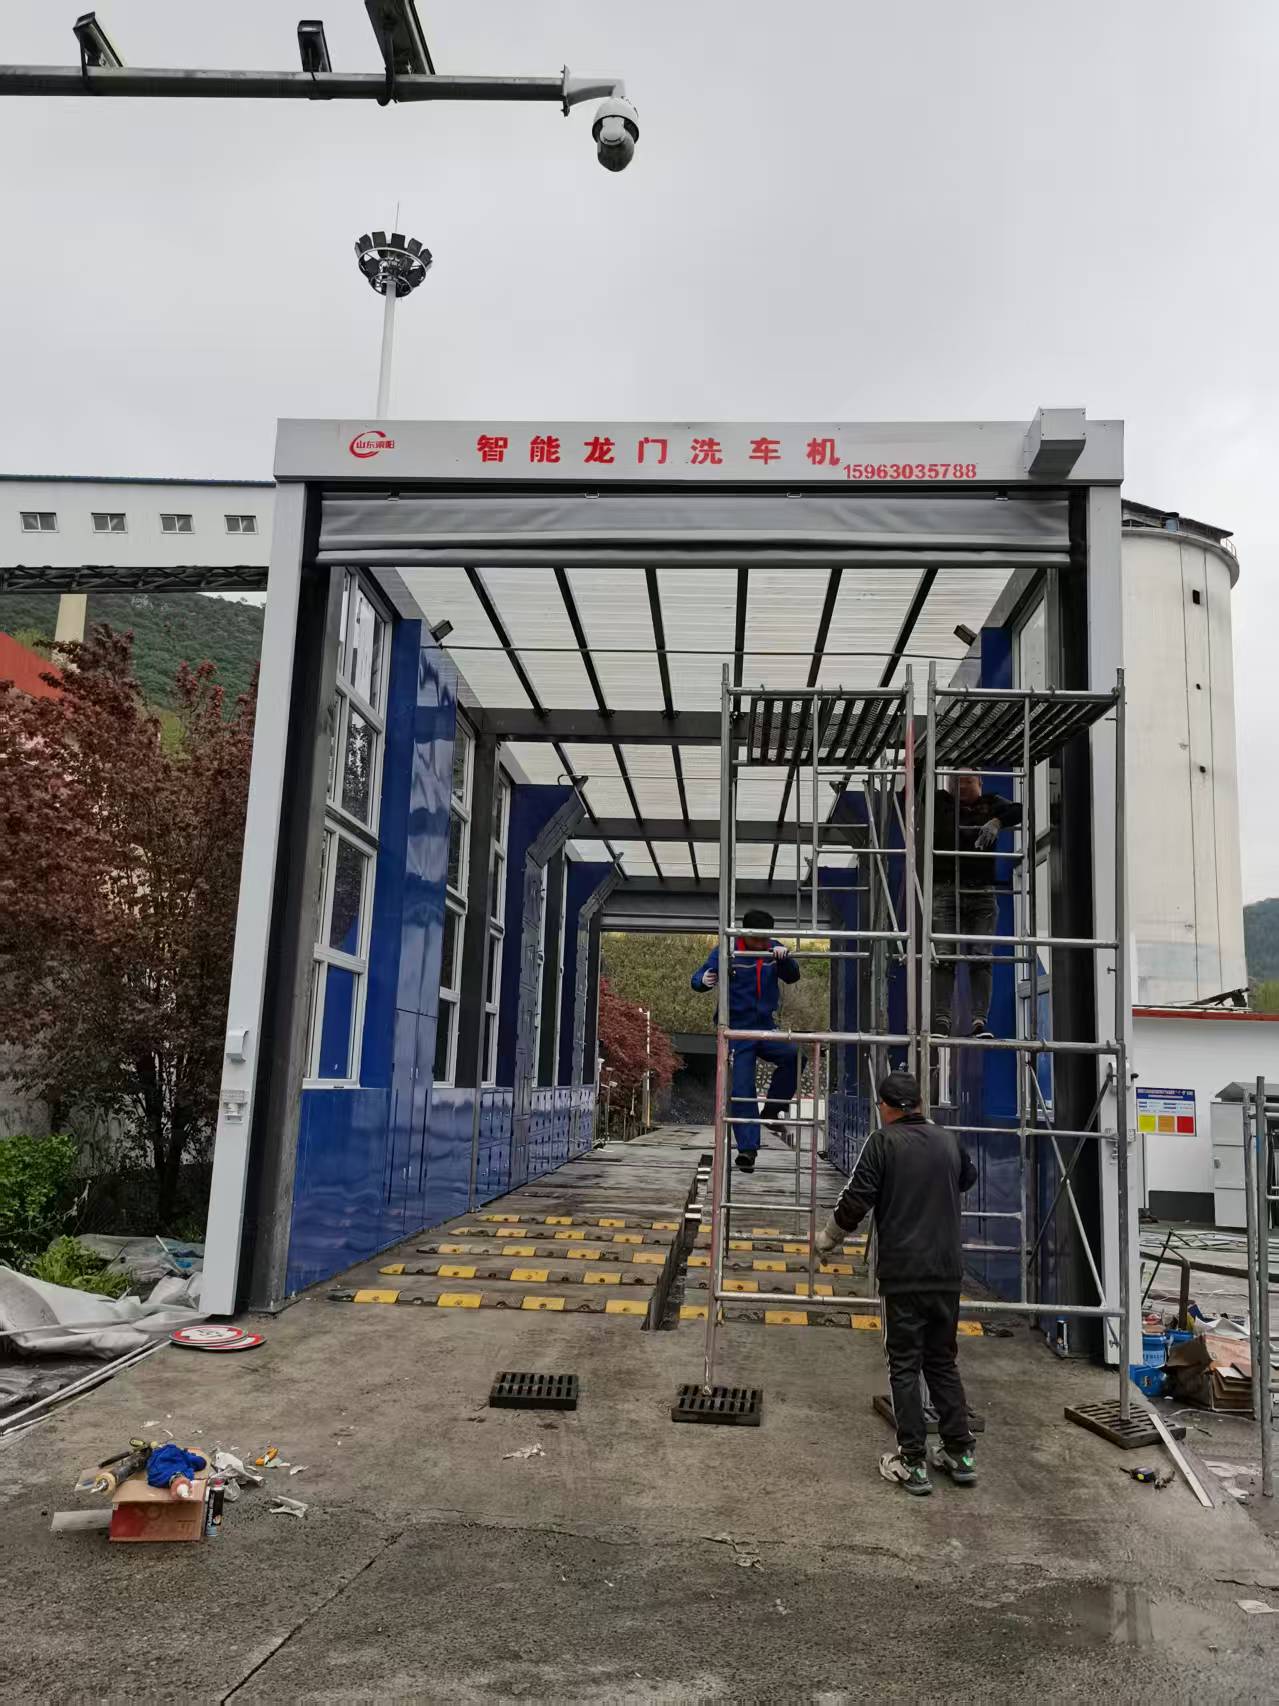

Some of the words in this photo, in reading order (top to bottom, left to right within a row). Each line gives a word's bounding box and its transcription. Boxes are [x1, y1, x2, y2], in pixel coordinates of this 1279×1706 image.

[476, 434, 841, 467] 智能龙门洗车机
[843, 463, 977, 480] 15963035788
